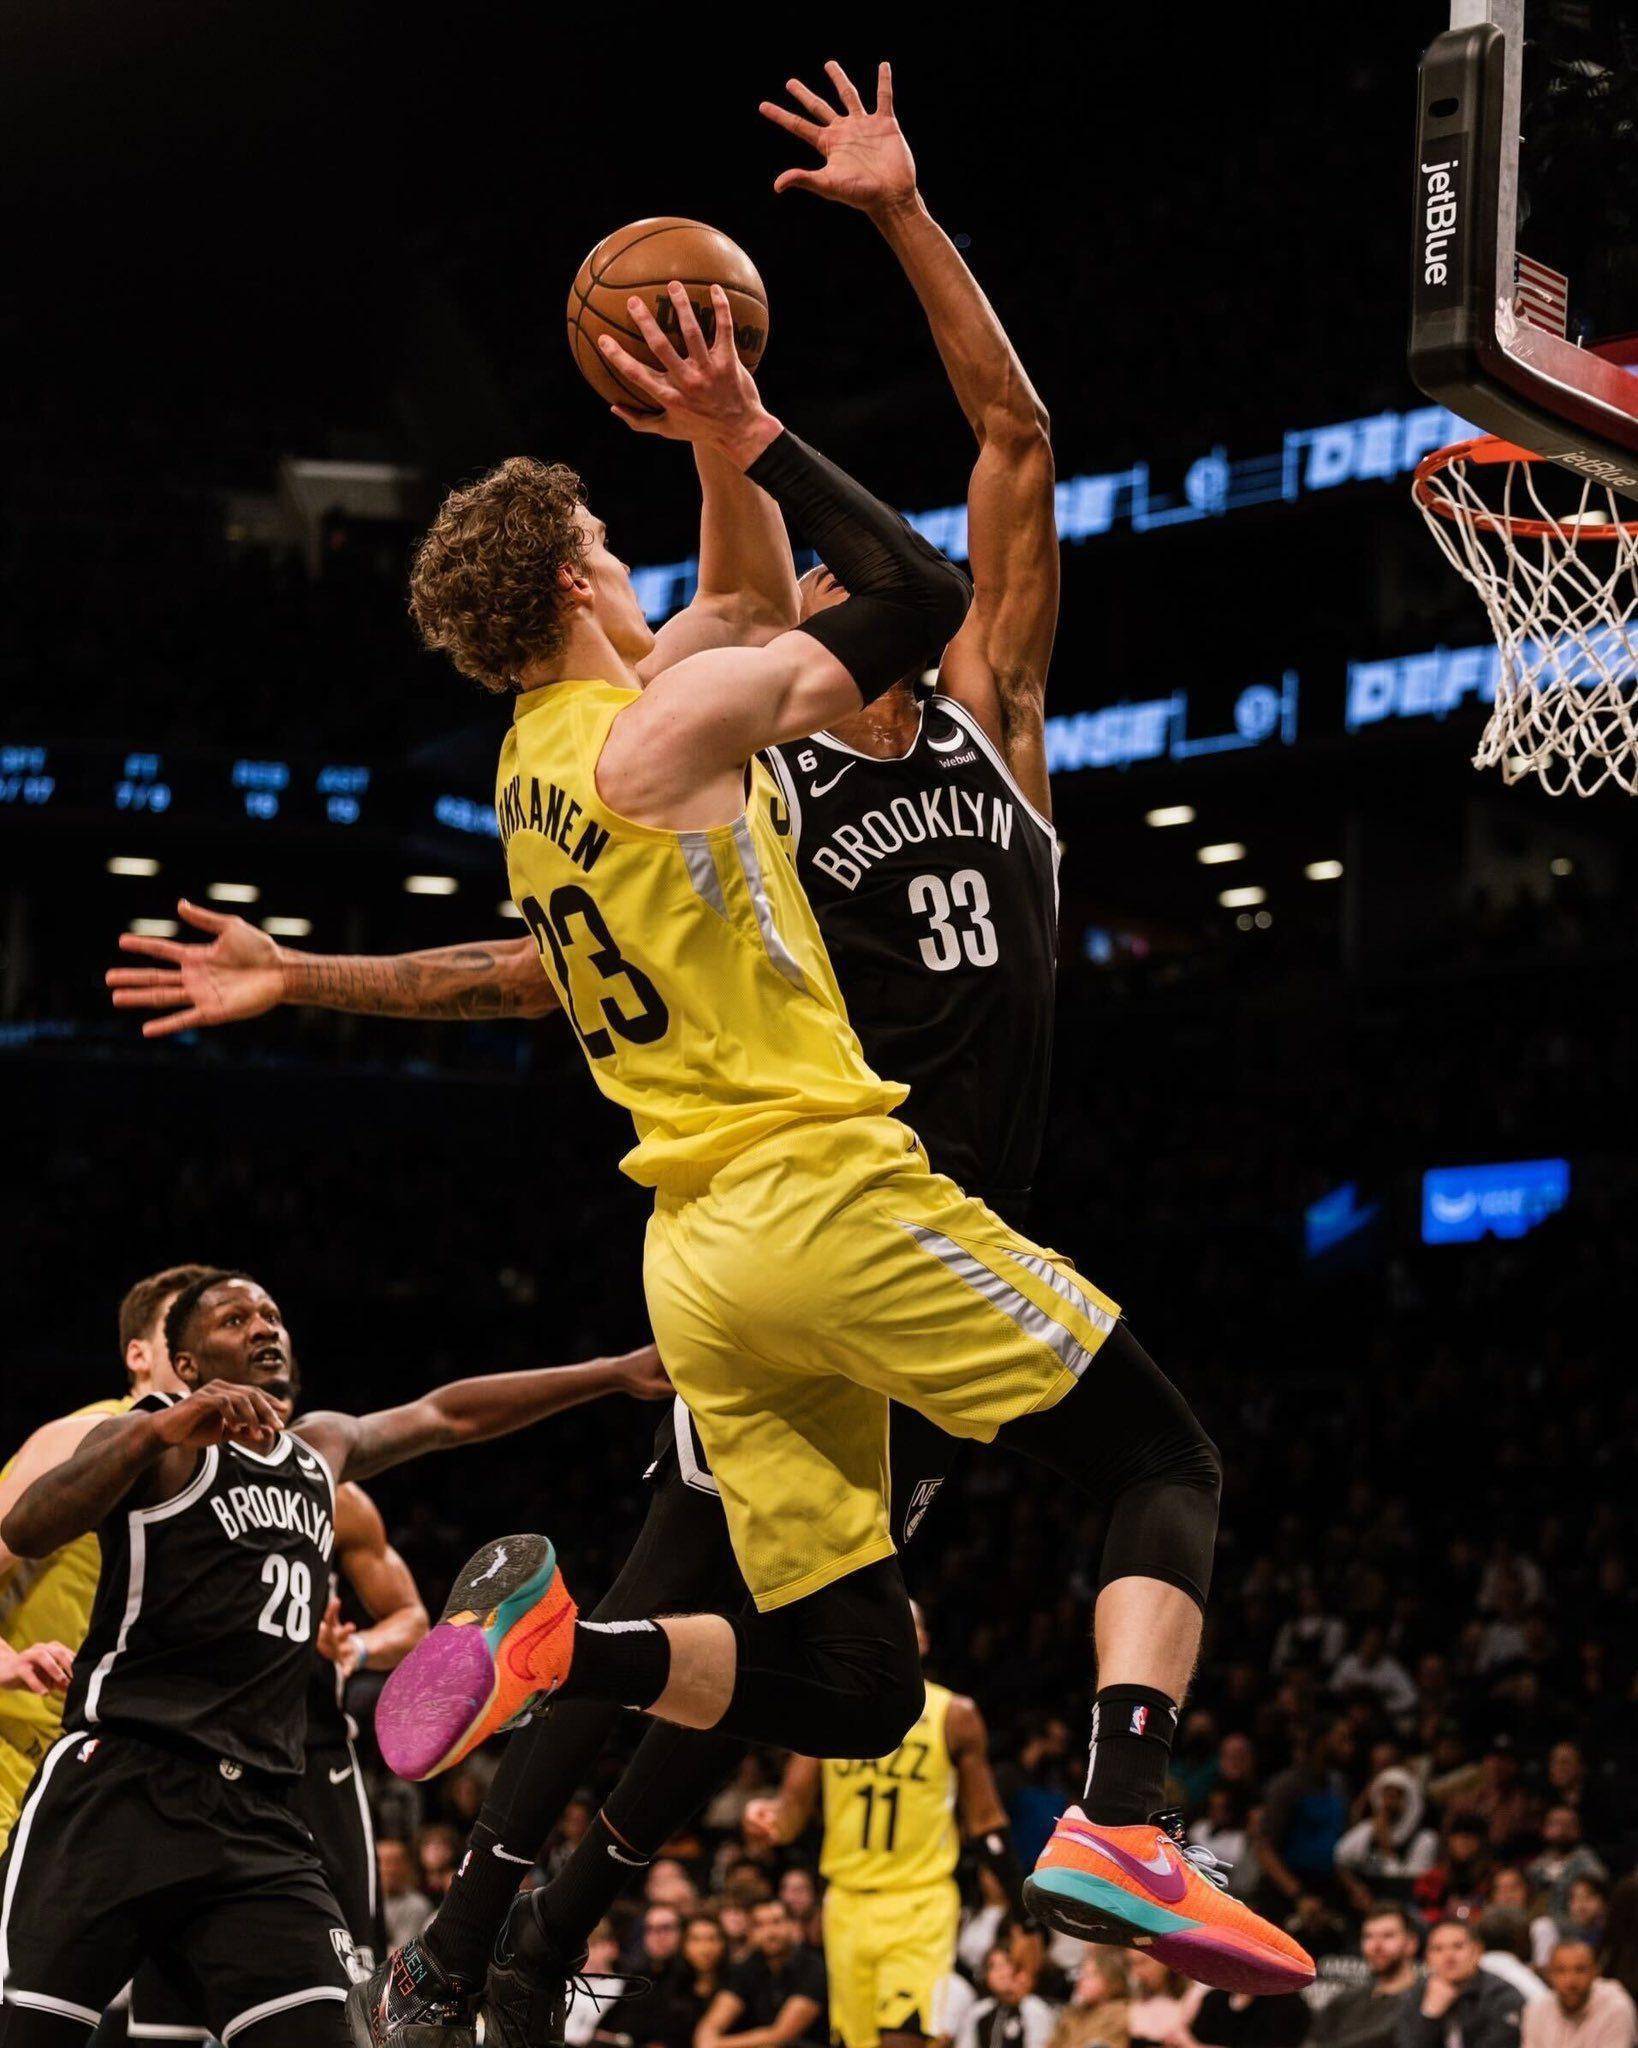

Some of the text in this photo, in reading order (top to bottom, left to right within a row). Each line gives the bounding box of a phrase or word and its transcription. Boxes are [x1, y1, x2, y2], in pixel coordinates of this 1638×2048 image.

[1421, 159, 1459, 286] jetBlue
[1546, 450, 1637, 487] jetBlue
[938, 750, 976, 768] Webull
[811, 785, 1013, 892] BROOKLYN
[908, 868, 999, 972] 33
[521, 884, 670, 1060] 23
[210, 1484, 335, 1563] BROOKLYN
[258, 1553, 312, 1643] 28
[856, 1784, 898, 1851] 11
